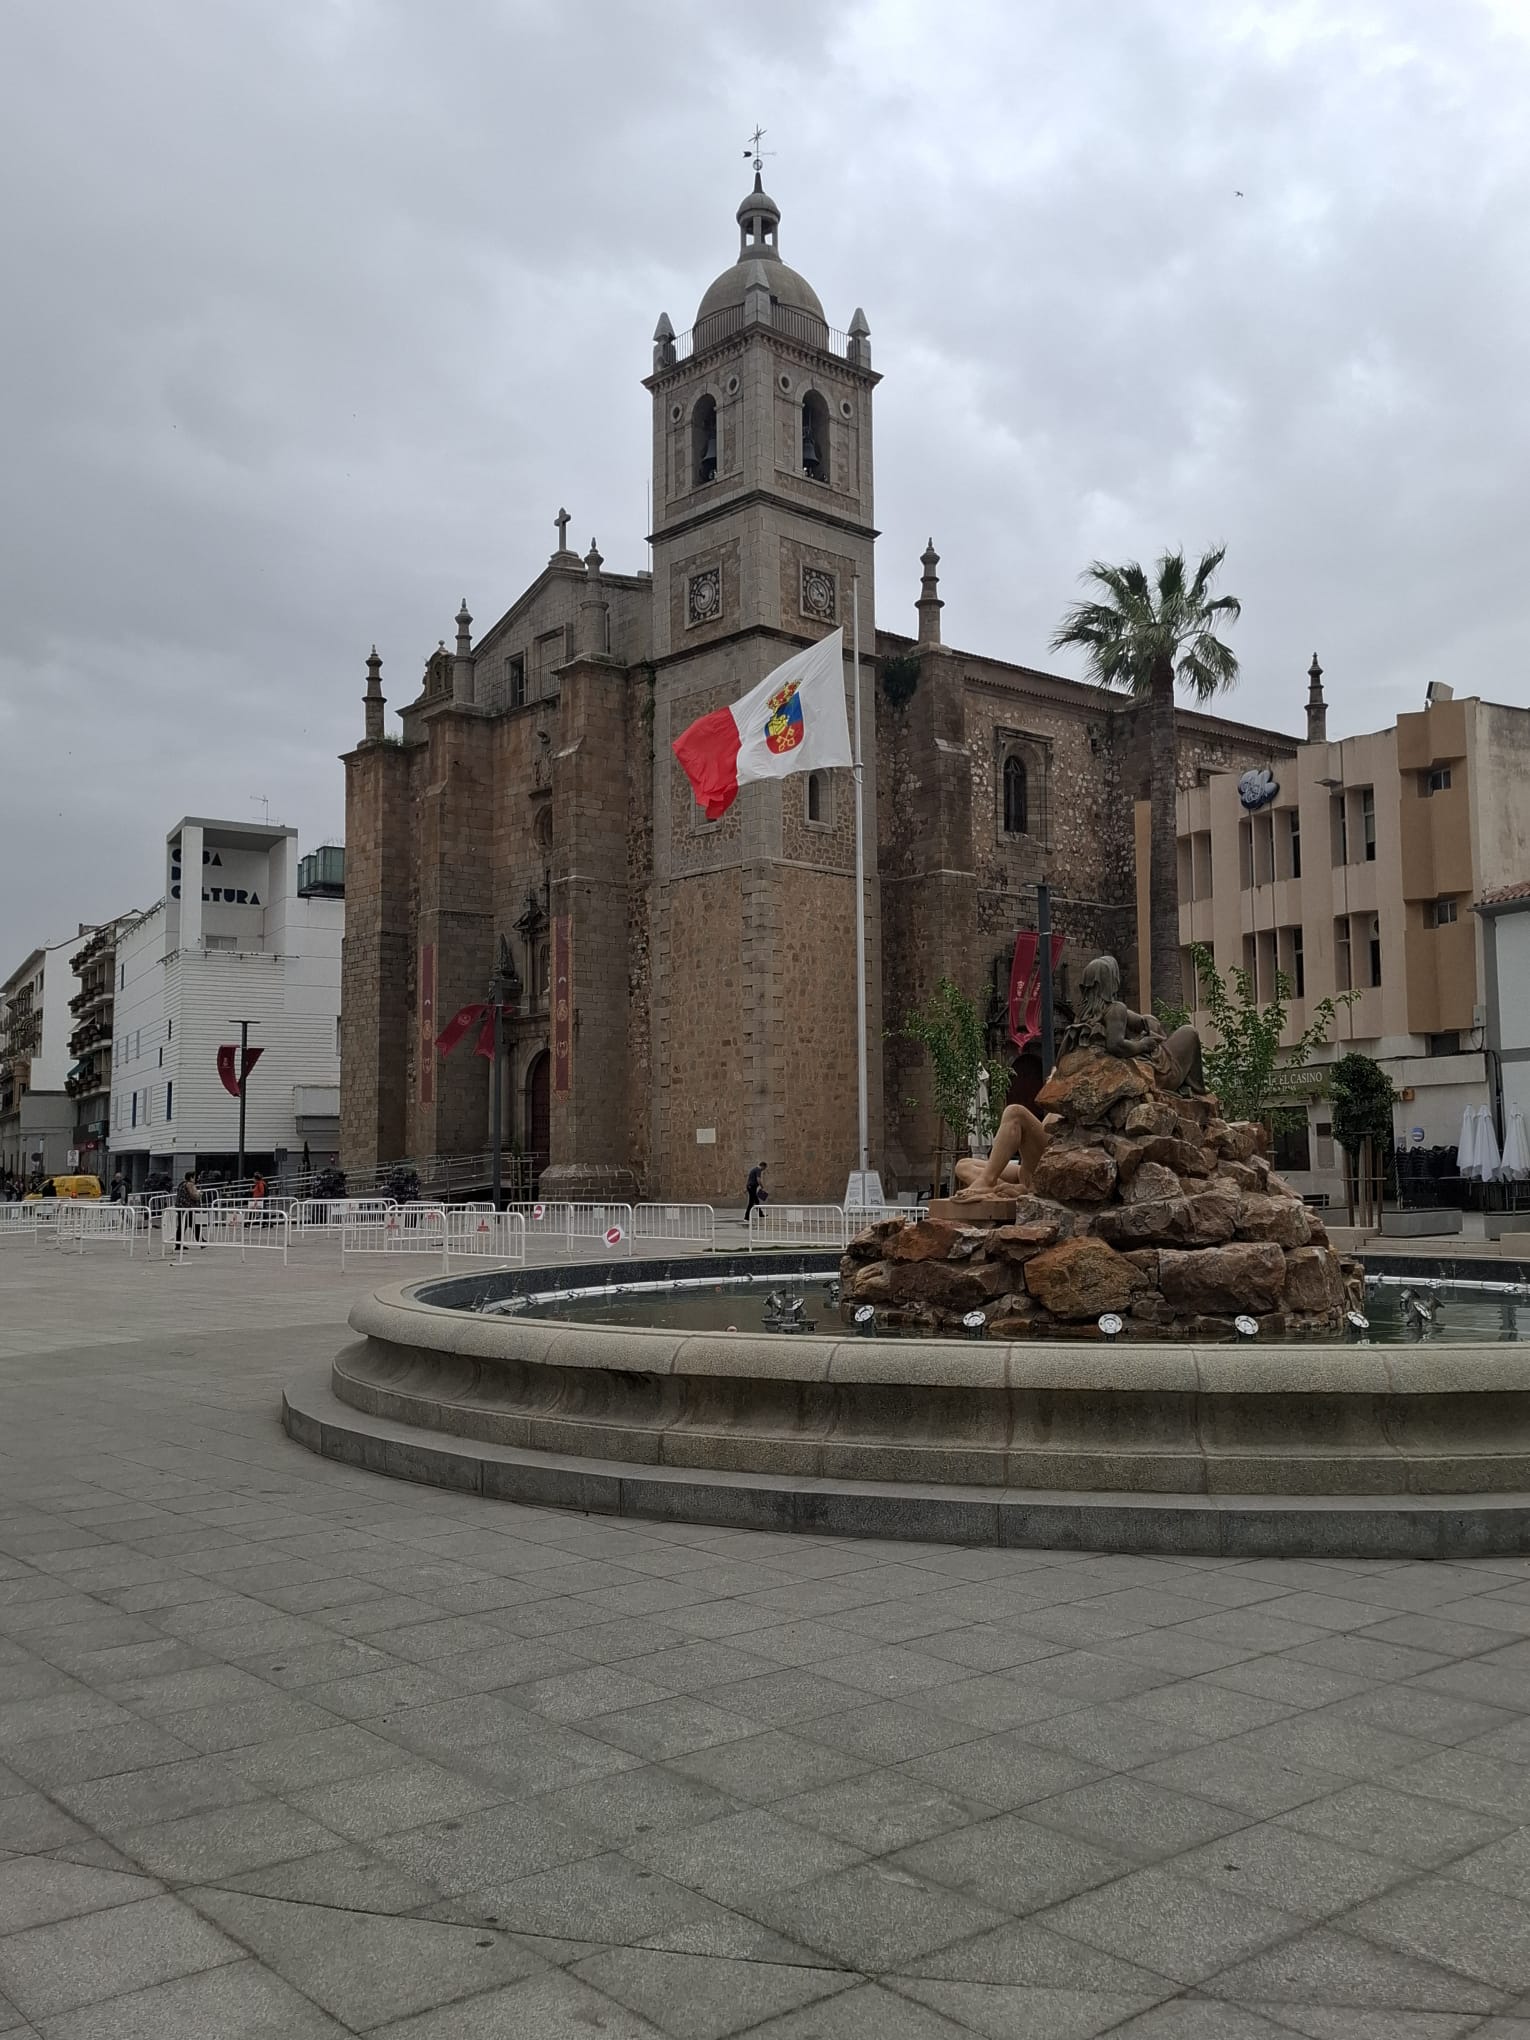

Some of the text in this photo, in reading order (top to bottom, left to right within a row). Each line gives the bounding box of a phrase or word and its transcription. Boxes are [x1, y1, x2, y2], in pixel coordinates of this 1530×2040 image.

[172, 848, 222, 866] CSA
[171, 885, 260, 905] CLTURA
[1290, 1071, 1323, 1084] CASINO
